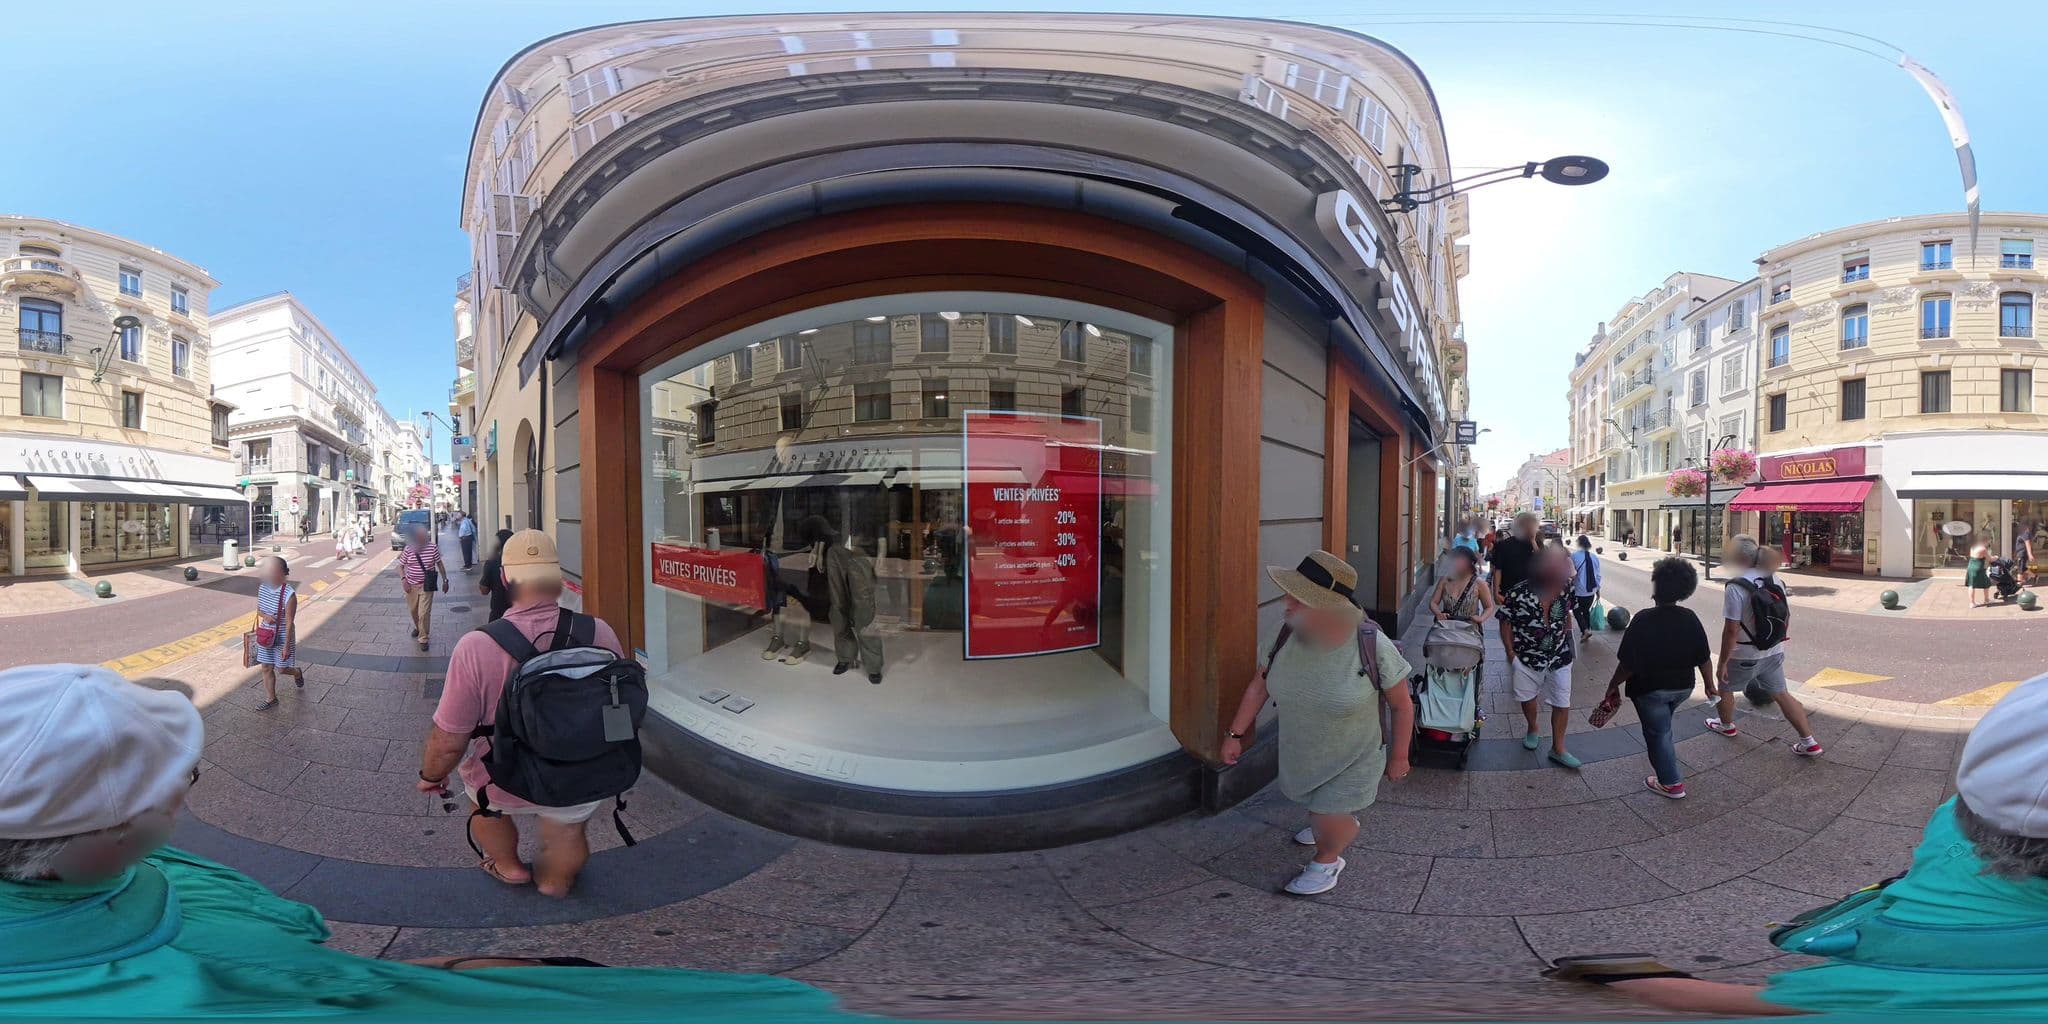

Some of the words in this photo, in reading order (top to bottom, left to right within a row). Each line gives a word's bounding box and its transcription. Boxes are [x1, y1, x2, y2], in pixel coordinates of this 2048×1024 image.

[21, 449, 105, 461] JACQUES
[1784, 462, 1832, 475] NICOLAS
[993, 488, 1025, 501] VENTES
[1054, 511, 1077, 524] -20%
[1054, 533, 1077, 546] -30%
[1054, 554, 1077, 567] -40%
[659, 558, 691, 578] VENTES
[693, 564, 737, 587] PRIVÉES
